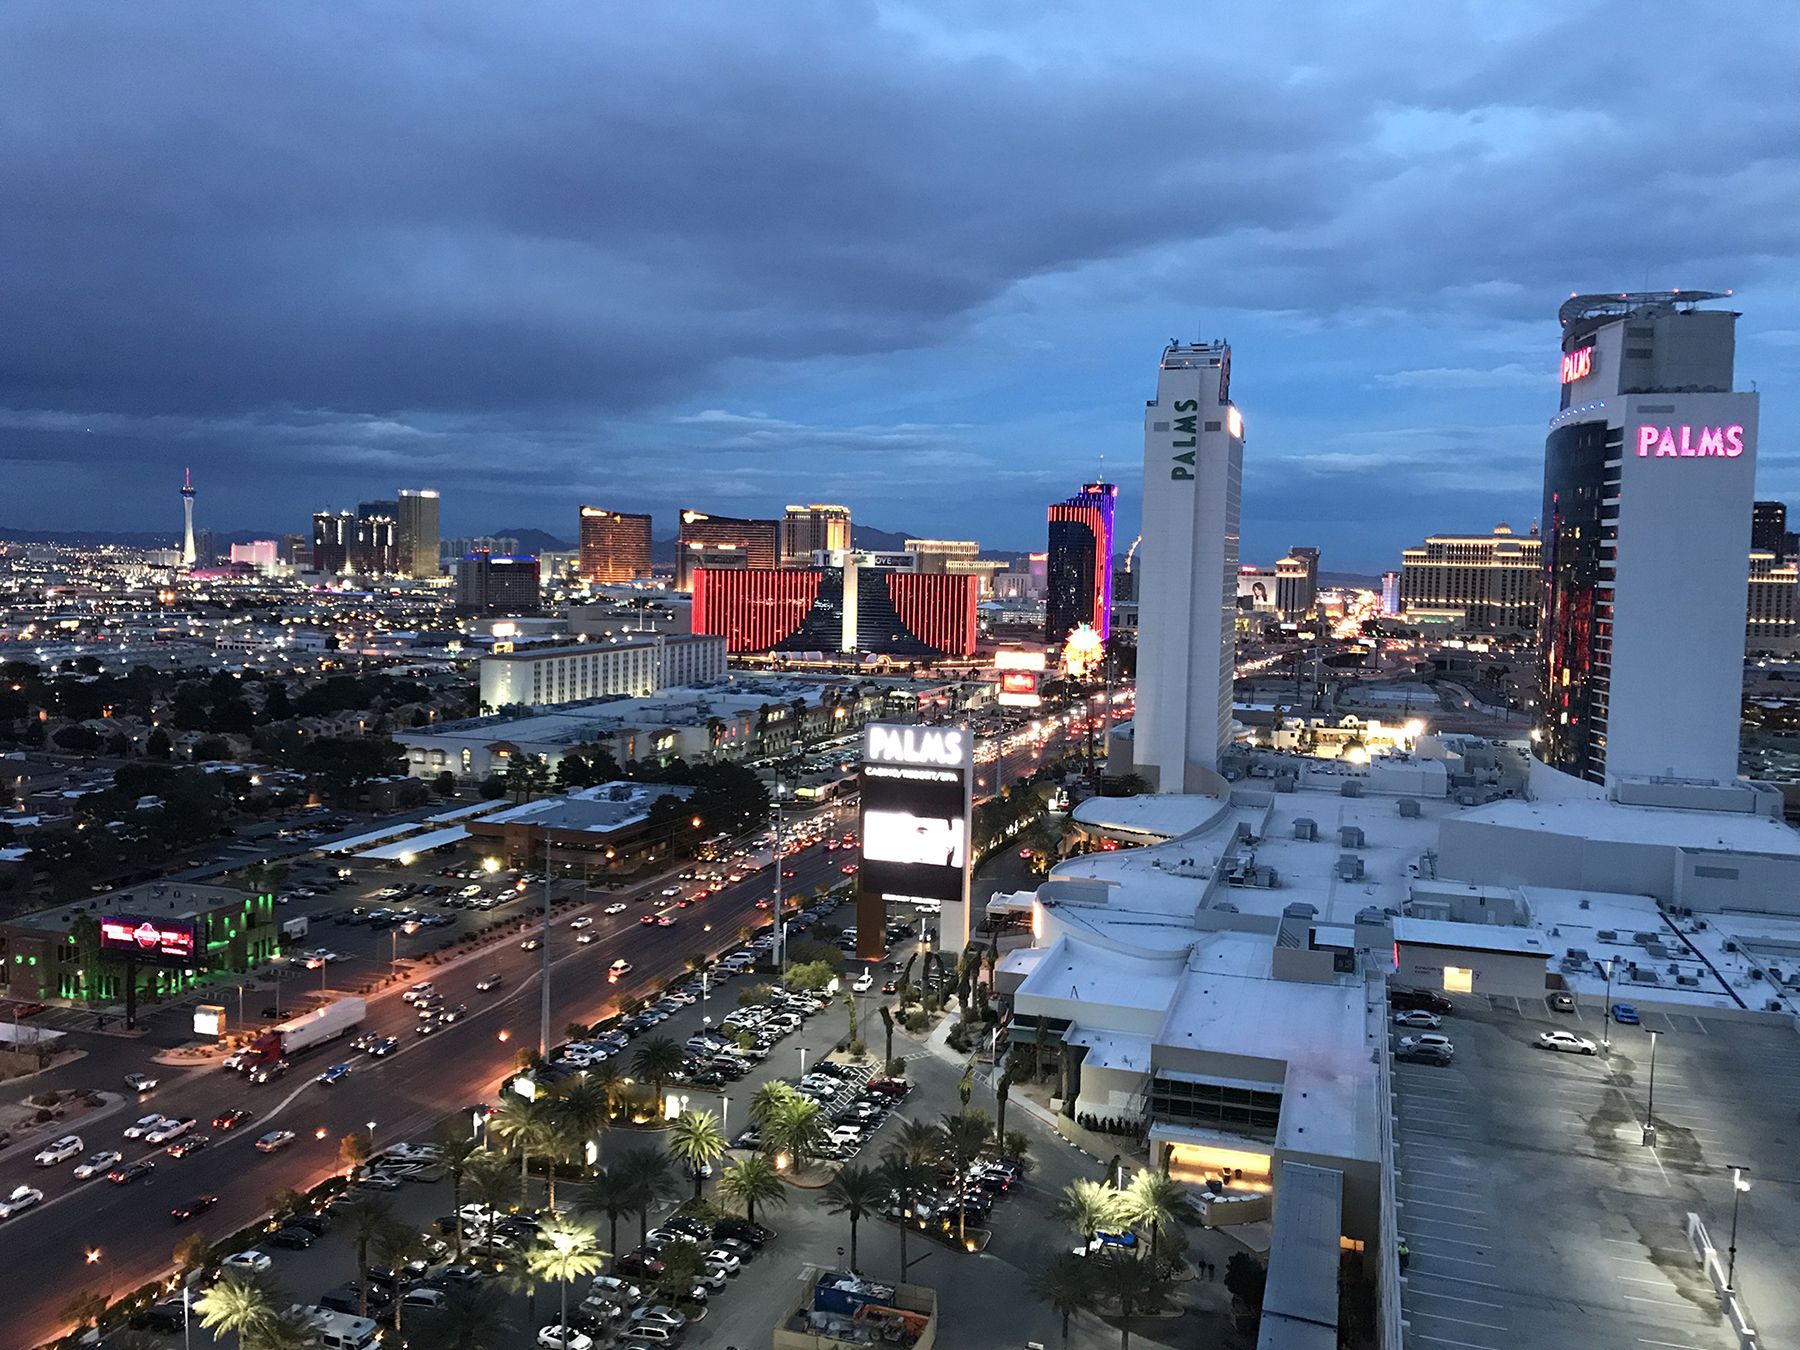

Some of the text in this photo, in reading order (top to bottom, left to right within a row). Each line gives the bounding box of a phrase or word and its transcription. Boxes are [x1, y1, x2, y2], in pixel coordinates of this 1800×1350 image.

[1561, 346, 1593, 384] PALMS
[1171, 399, 1198, 481] PALMS
[1637, 424, 1744, 457] PALMS
[869, 726, 962, 765] PALMS
